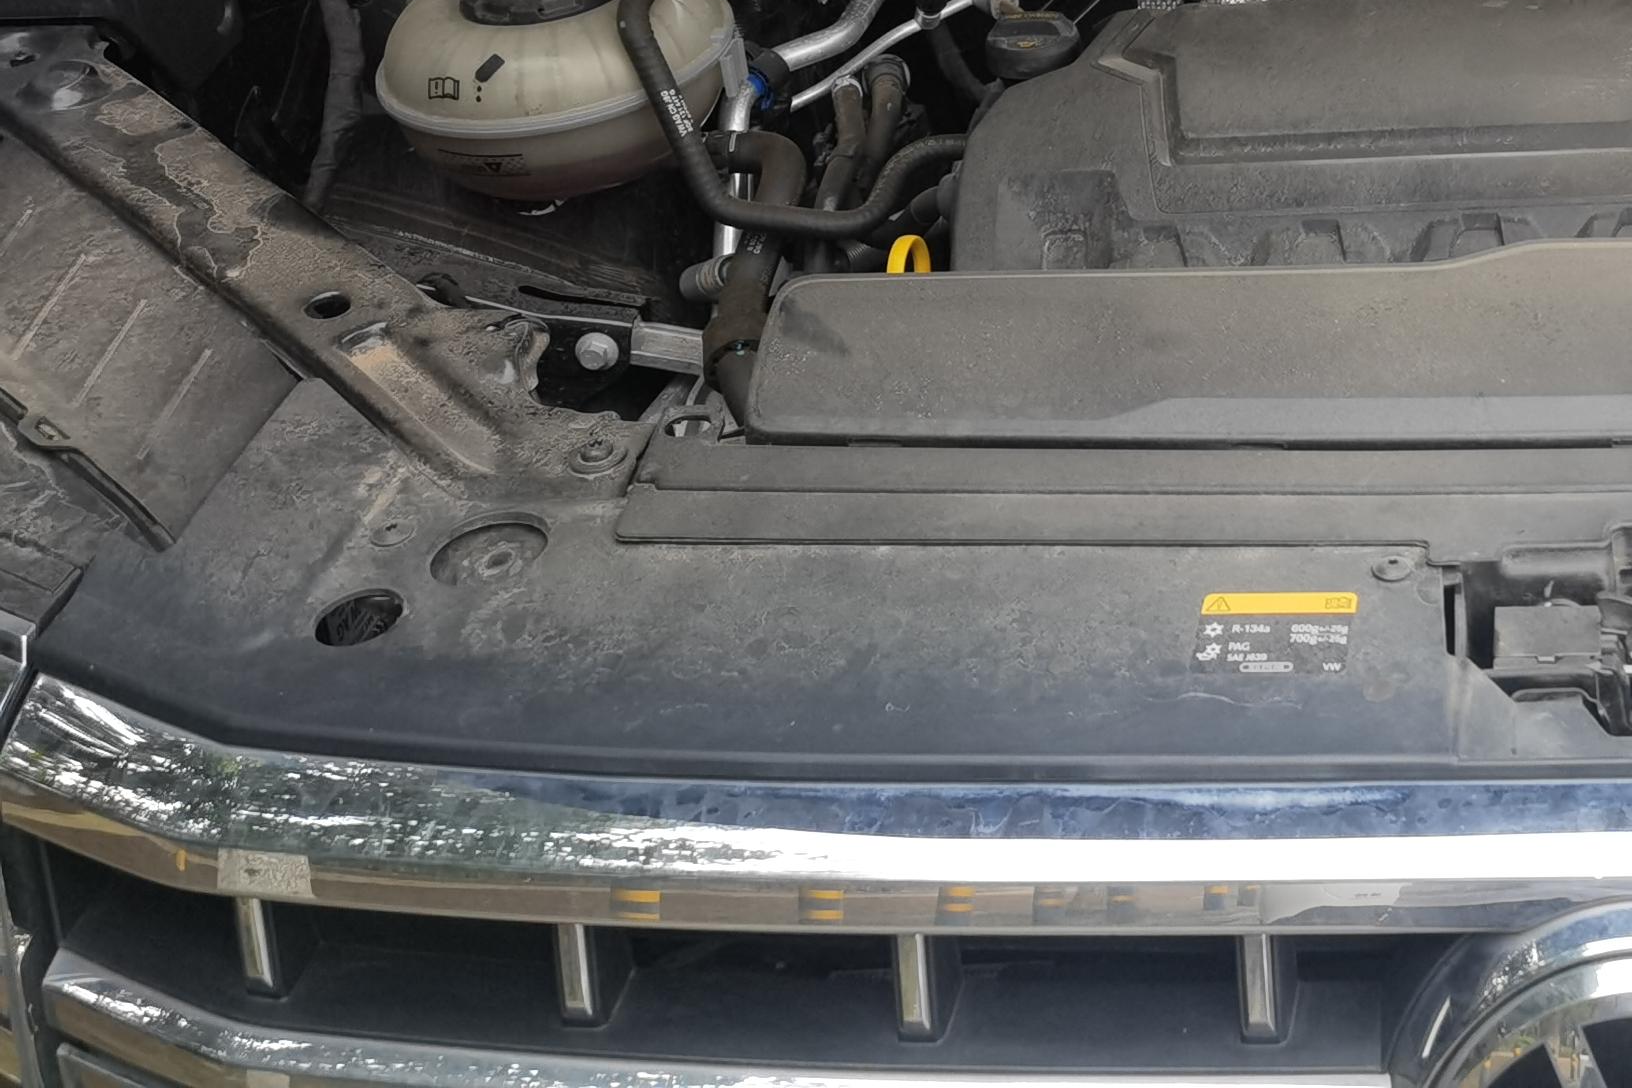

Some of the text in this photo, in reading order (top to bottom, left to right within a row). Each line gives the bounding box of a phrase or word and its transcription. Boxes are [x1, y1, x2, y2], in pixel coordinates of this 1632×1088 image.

[1231, 624, 1271, 634] R-134a
[1228, 641, 1251, 652] PAG
[1322, 662, 1342, 672] VW
